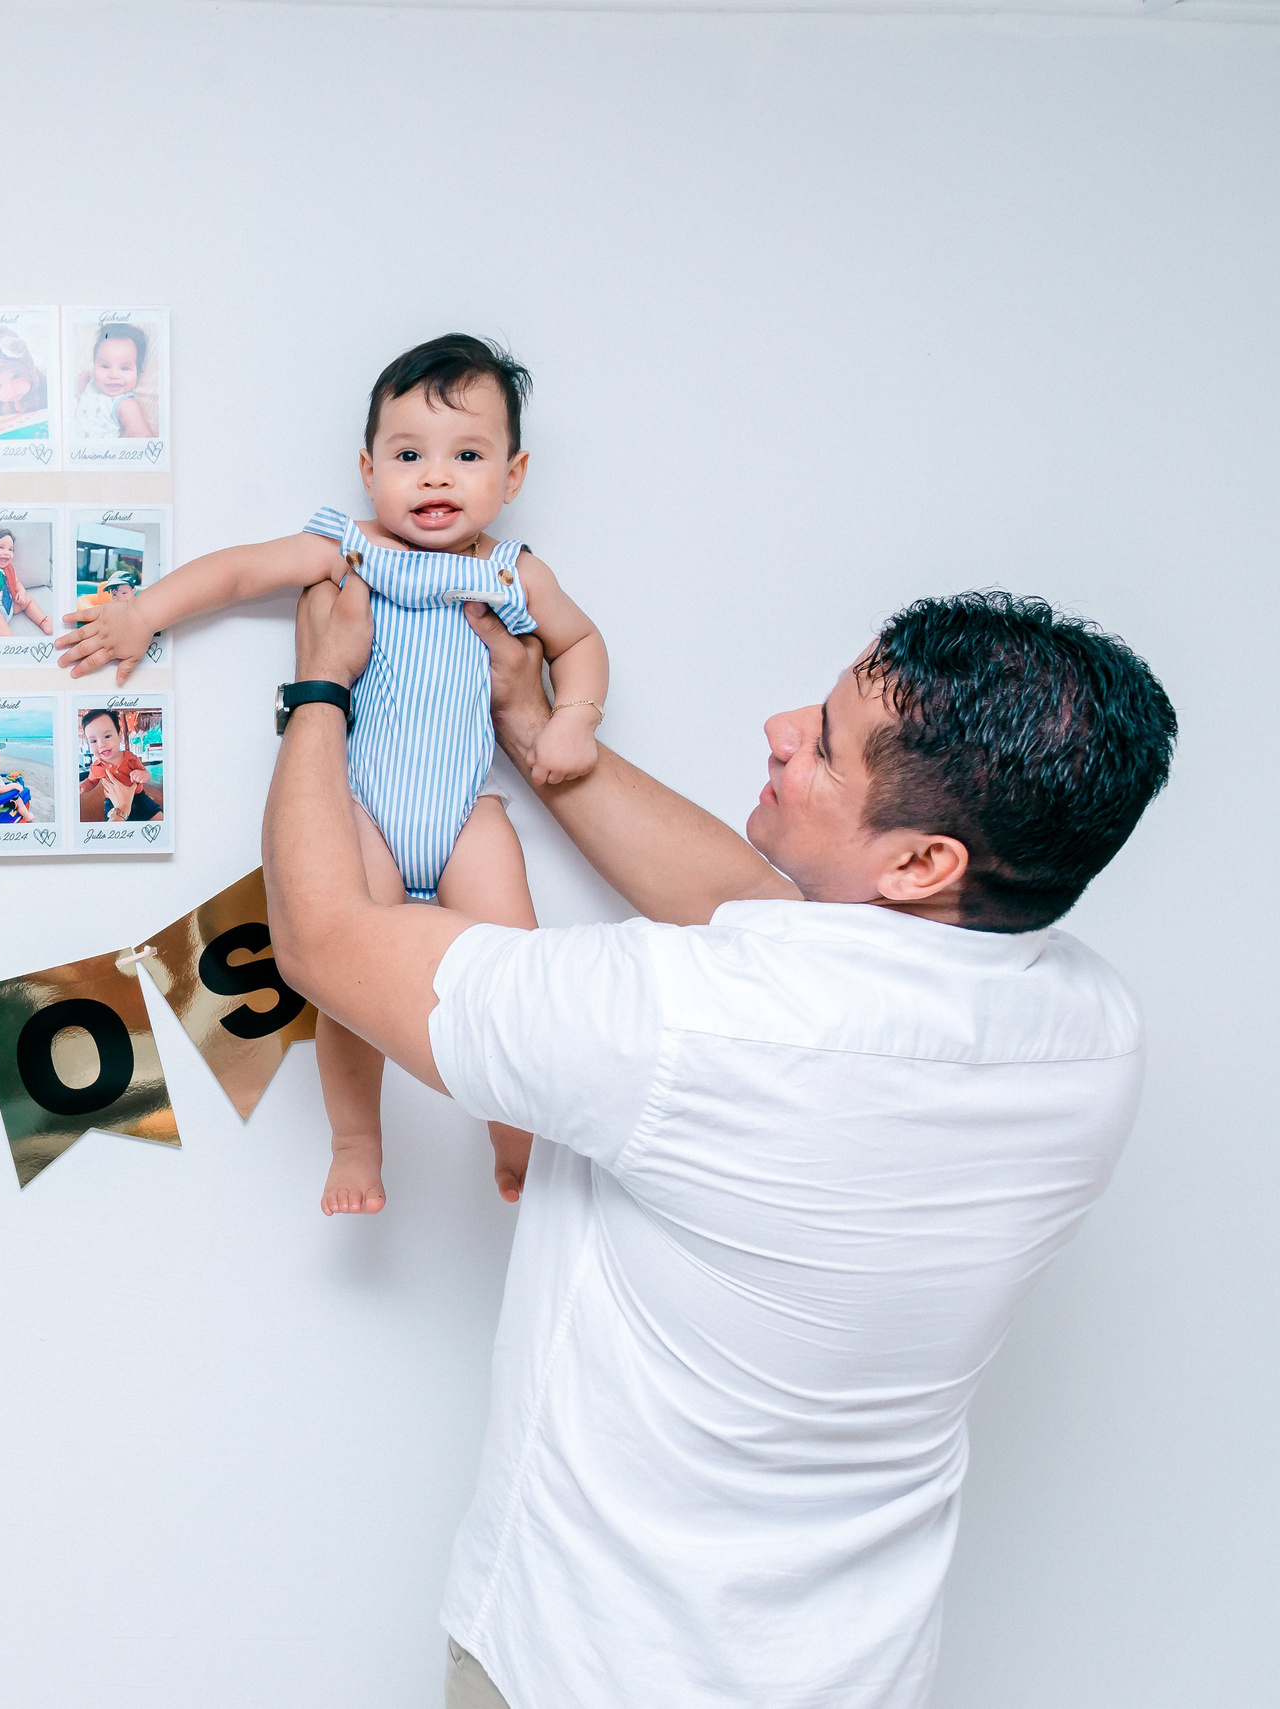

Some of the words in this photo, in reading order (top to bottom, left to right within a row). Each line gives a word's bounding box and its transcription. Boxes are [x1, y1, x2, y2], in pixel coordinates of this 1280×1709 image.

[98, 310, 131, 326] Gabriel
[2, 446, 28, 457] 2023
[70, 447, 117, 460] Noviembre
[118, 450, 144, 460] 2023
[100, 509, 133, 525] Gabriel
[2, 645, 29, 655] 2024
[106, 696, 140, 711] Gabriel
[2, 832, 29, 841] 2024
[83, 828, 107, 844] Julio
[107, 830, 135, 840] 2024
